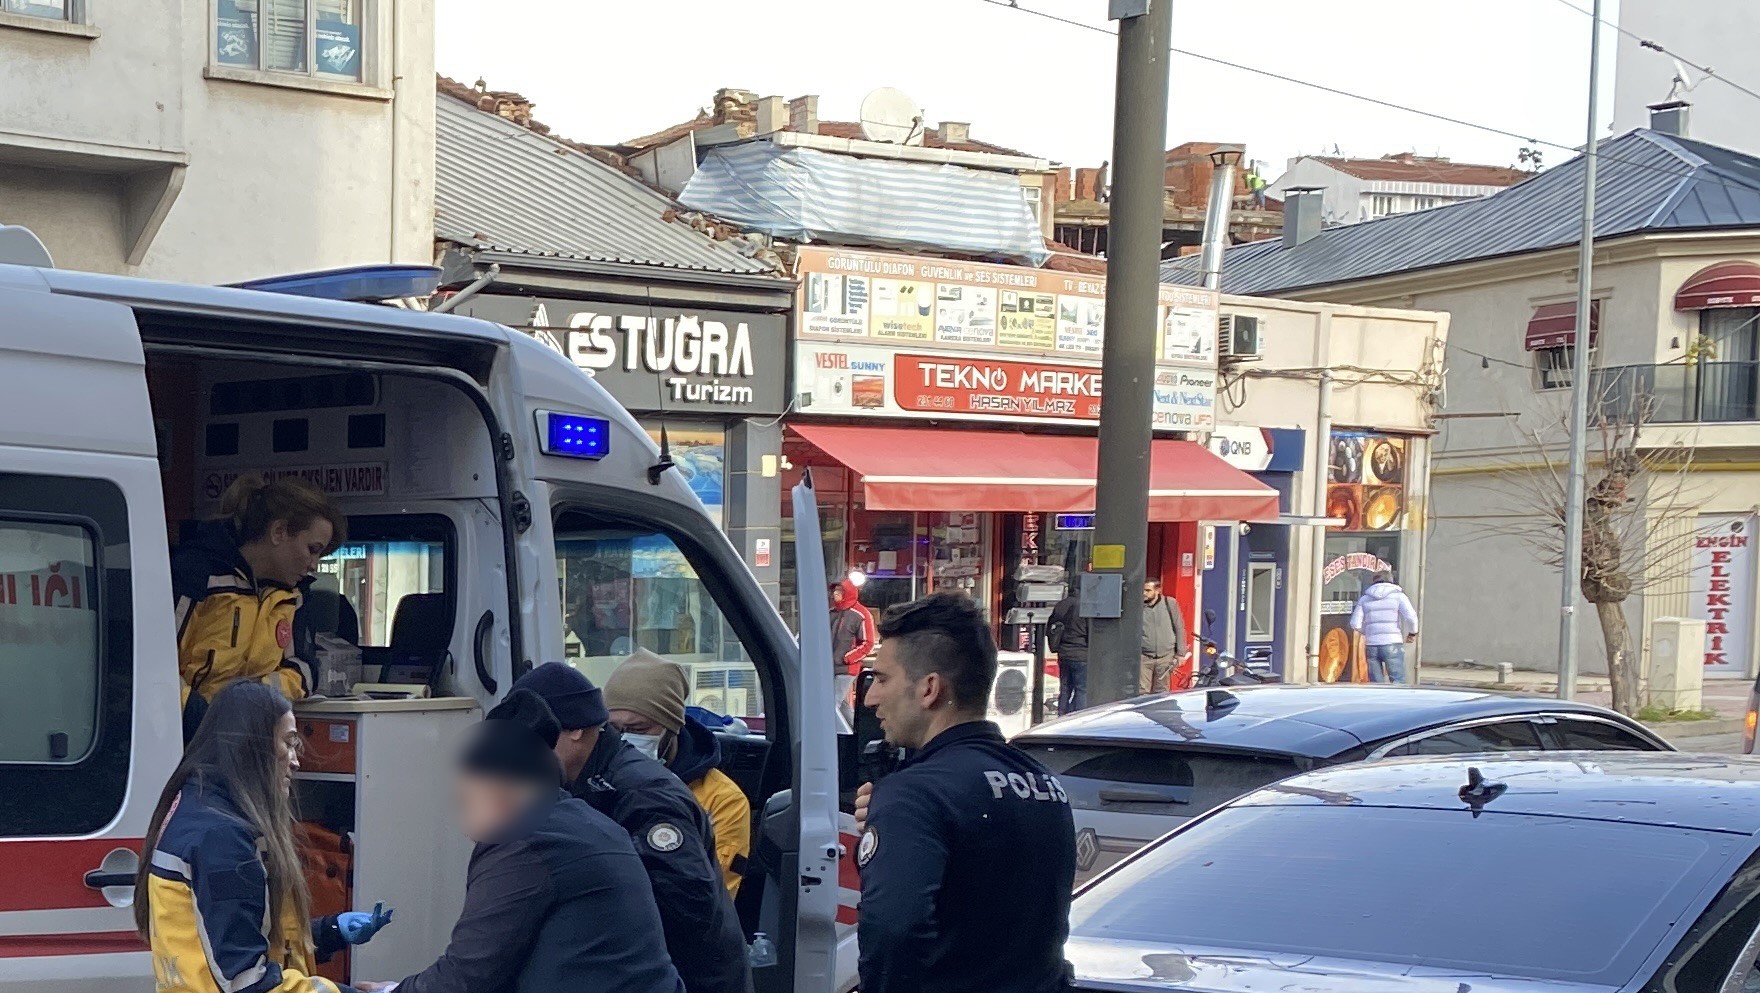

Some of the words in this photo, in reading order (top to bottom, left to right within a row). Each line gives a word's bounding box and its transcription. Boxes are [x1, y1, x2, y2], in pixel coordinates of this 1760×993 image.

[815, 352, 850, 370] VESTEL
[850, 361, 885, 372] SUNNY
[917, 362, 1008, 391] TEKNO
[1019, 369, 1102, 397] MARKE
[669, 377, 753, 403] Turizm
[970, 393, 1019, 411] HASAN
[1022, 397, 1076, 414] YILMAZ
[1230, 440, 1252, 456] QNB
[1696, 534, 1748, 548] ENGİN
